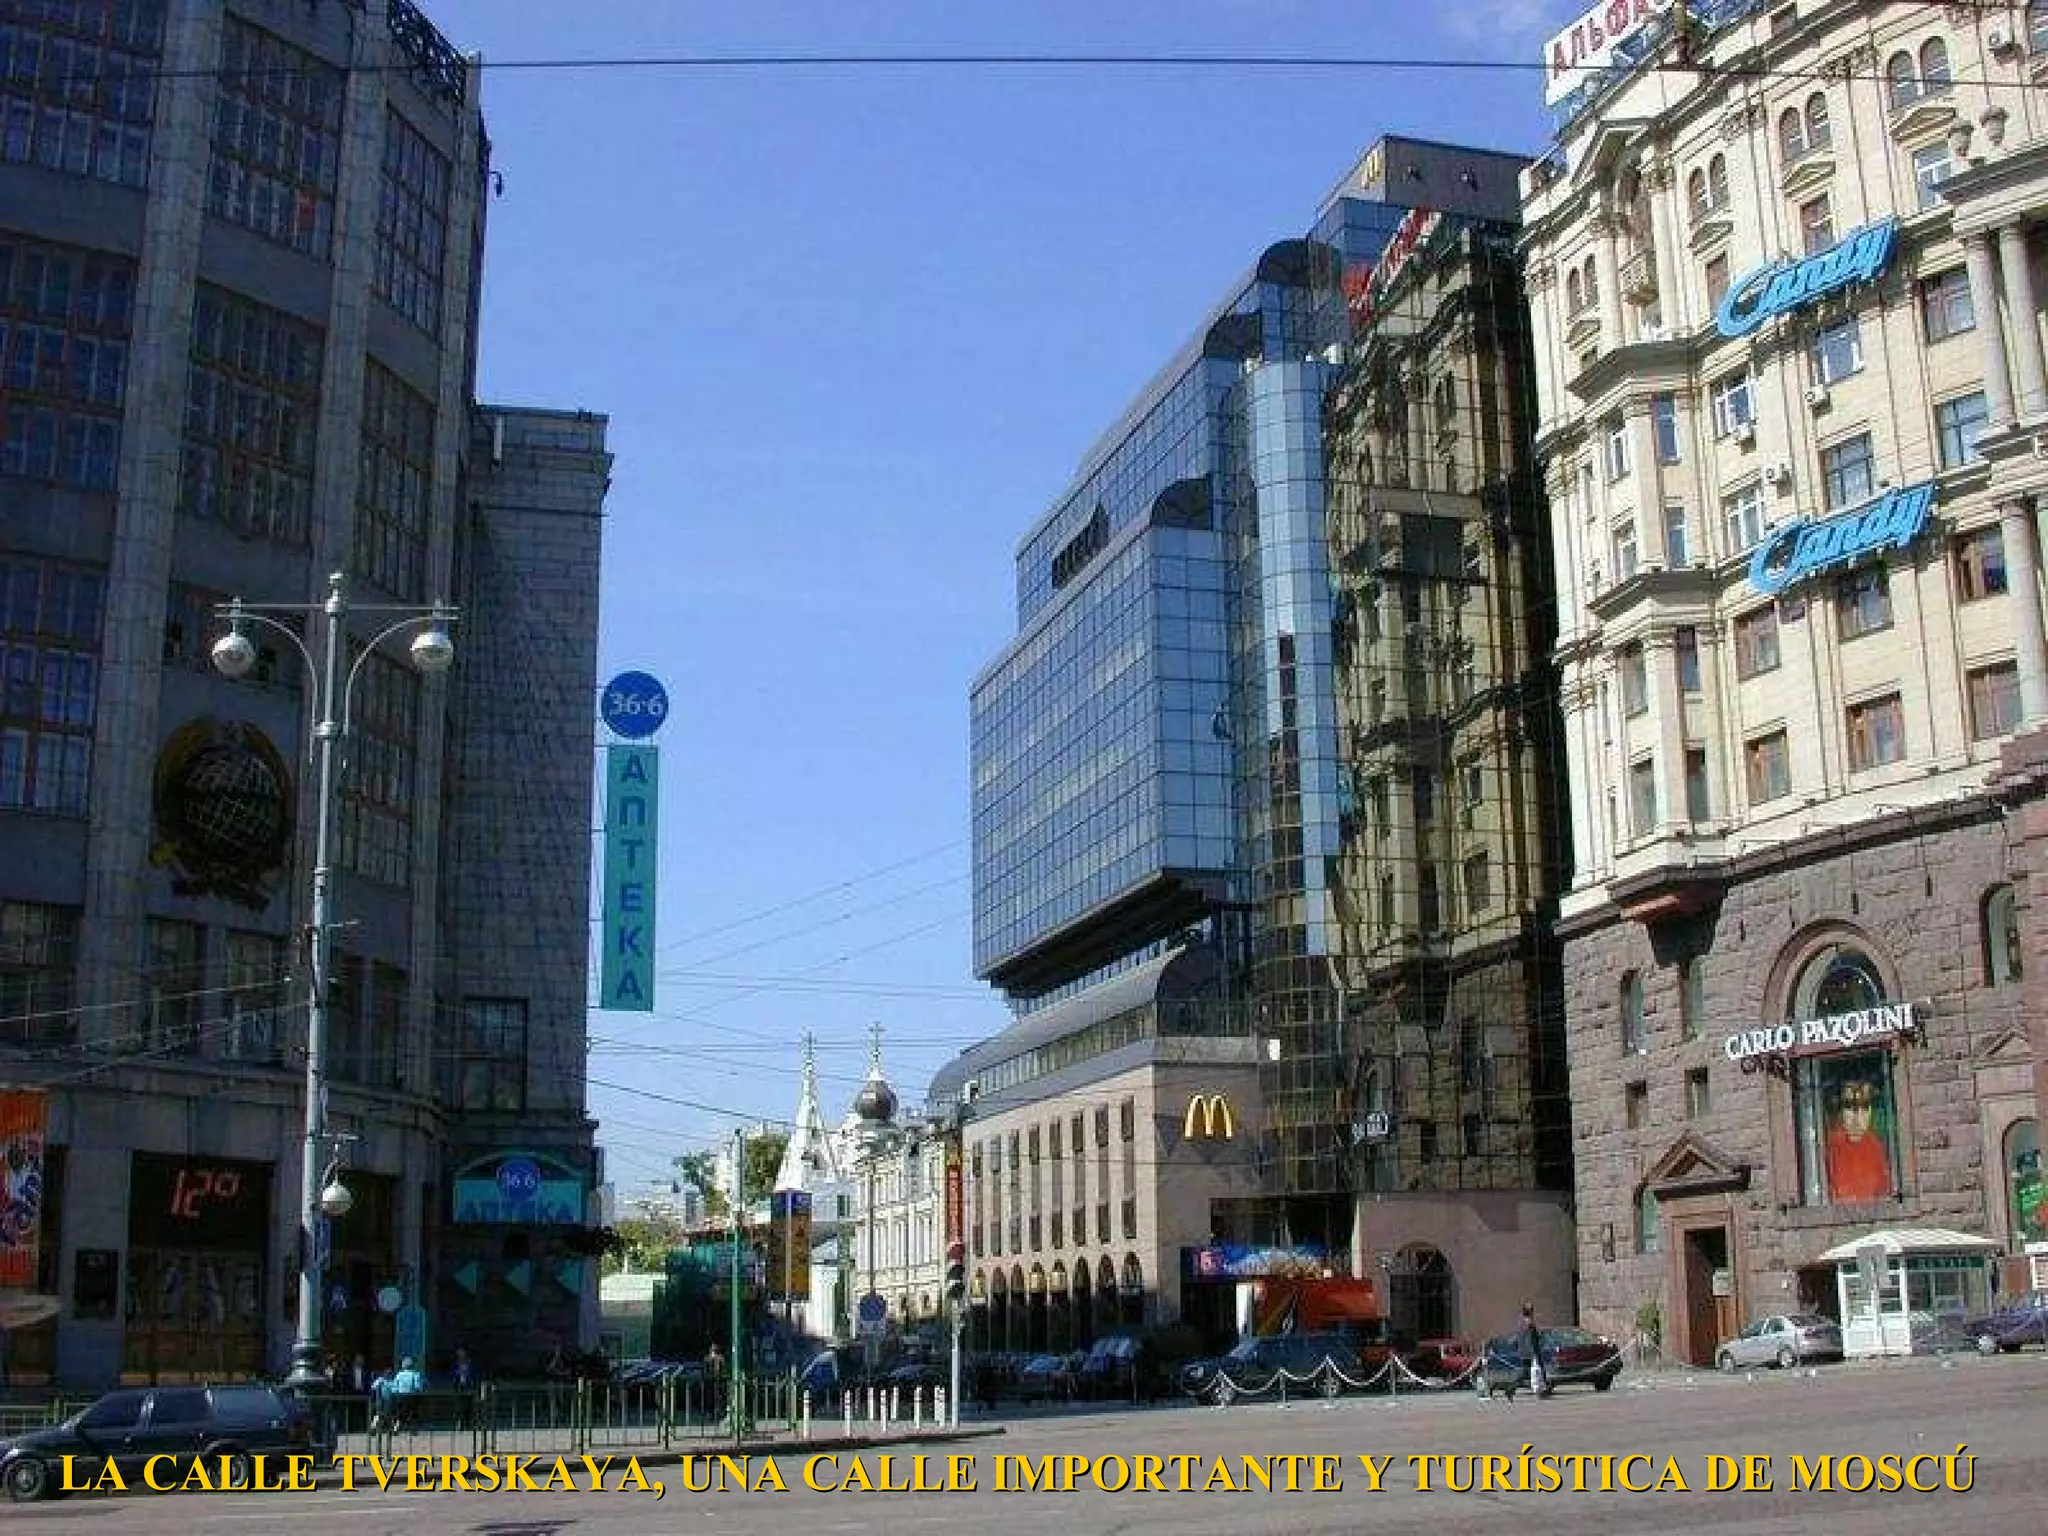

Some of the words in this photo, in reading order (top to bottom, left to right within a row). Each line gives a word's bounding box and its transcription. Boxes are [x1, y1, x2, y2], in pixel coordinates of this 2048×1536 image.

[1717, 217, 1896, 336] Candy
[1749, 484, 1934, 594] Candy
[616, 754, 648, 1001] АПТЕКА
[1725, 1024, 1795, 1060] CARLO
[1801, 1002, 1914, 1045] PAZOLINI
